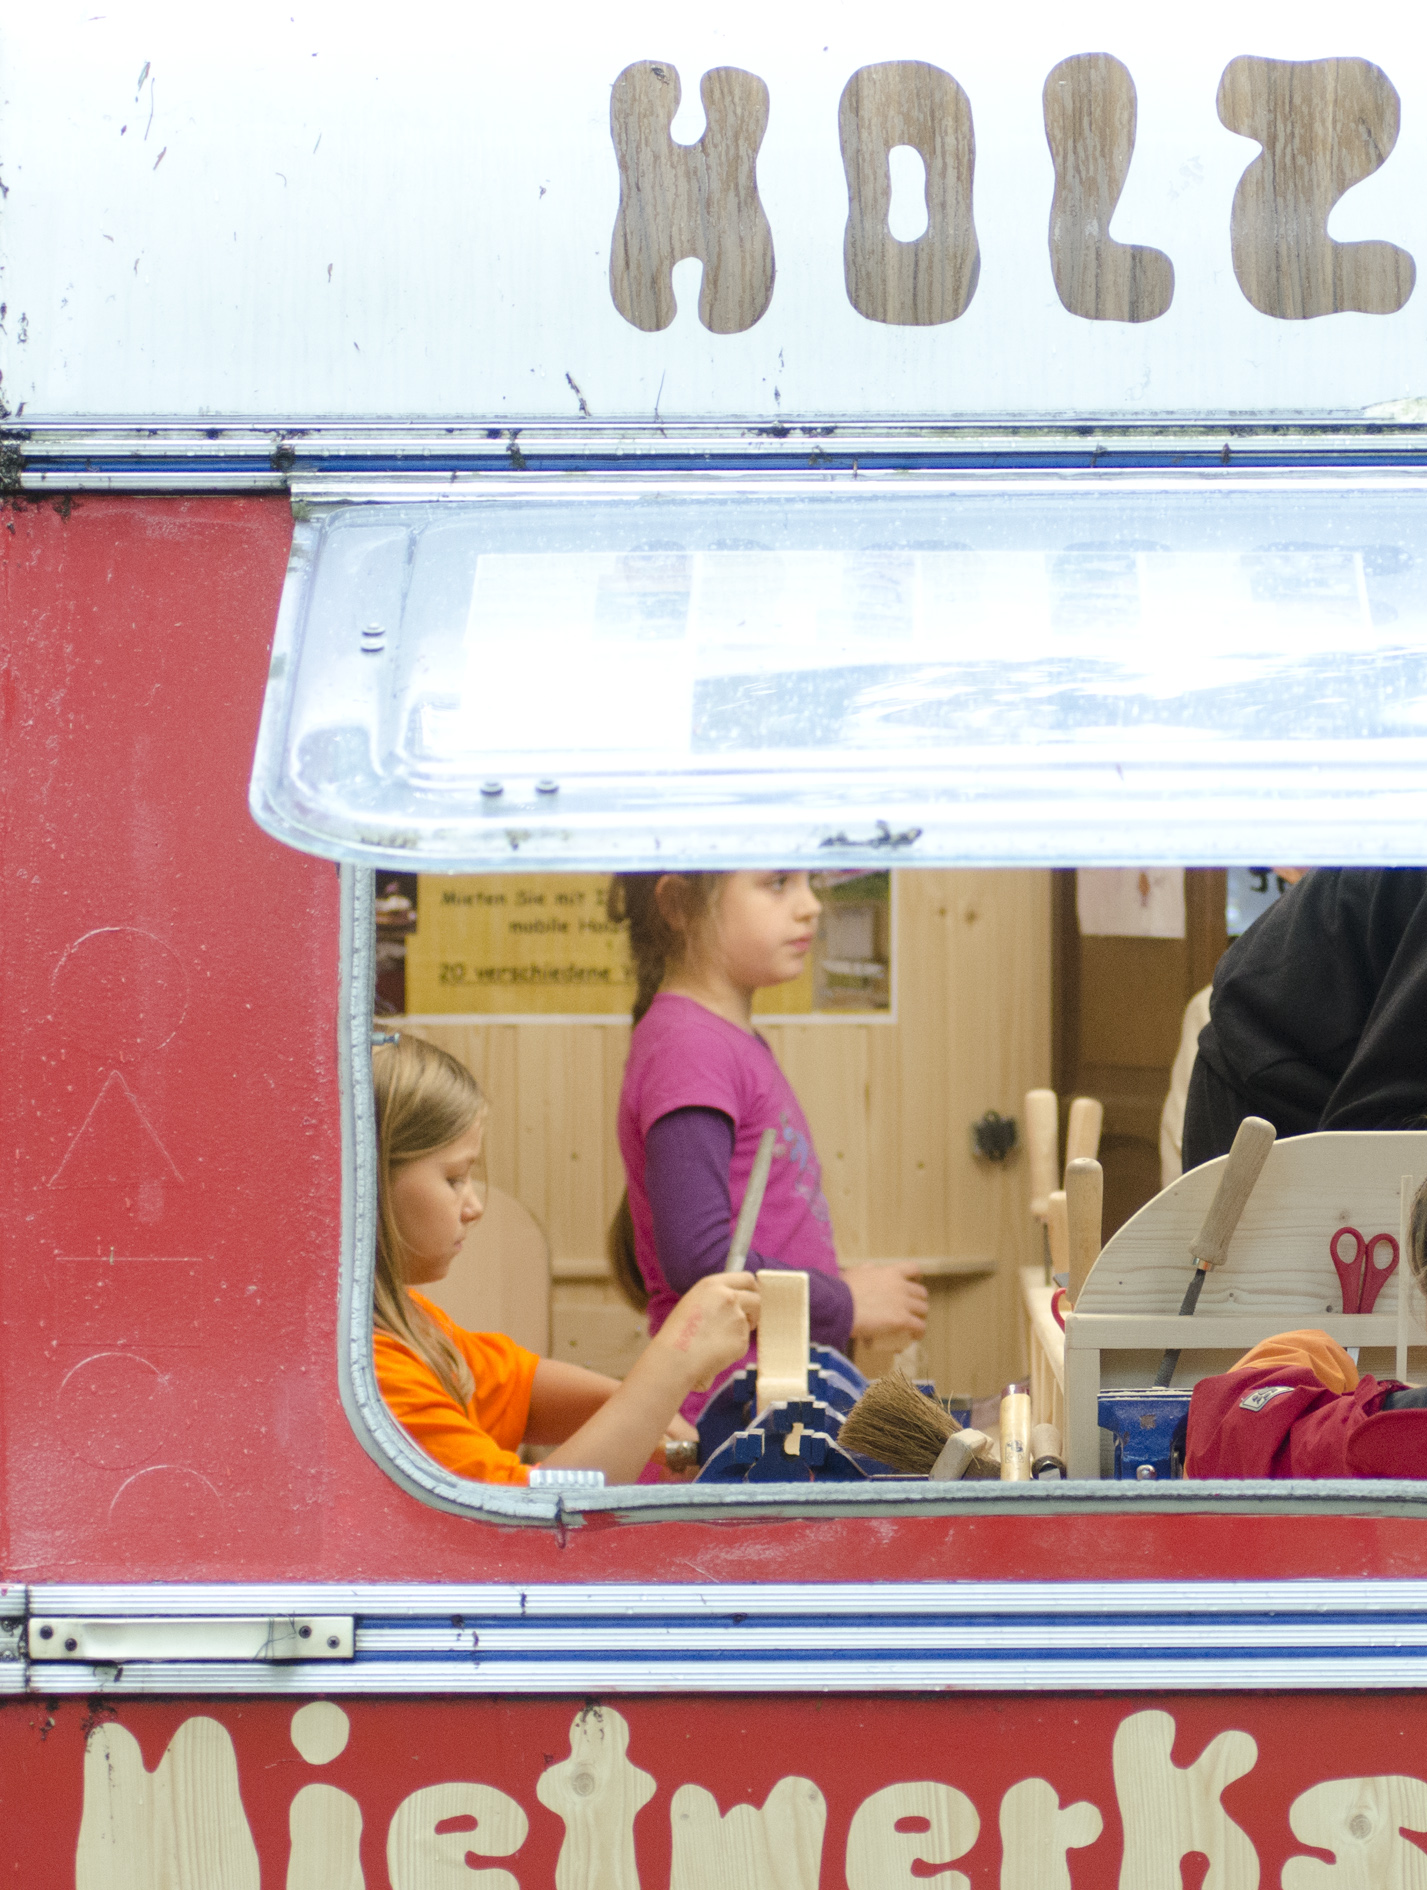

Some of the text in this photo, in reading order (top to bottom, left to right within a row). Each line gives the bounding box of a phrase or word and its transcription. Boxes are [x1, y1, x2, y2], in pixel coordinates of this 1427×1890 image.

[514, 888, 545, 906] Sie
[555, 889, 586, 906] mit
[508, 918, 569, 934] mobile
[439, 962, 466, 983] 20
[474, 962, 610, 983] verschiedene
